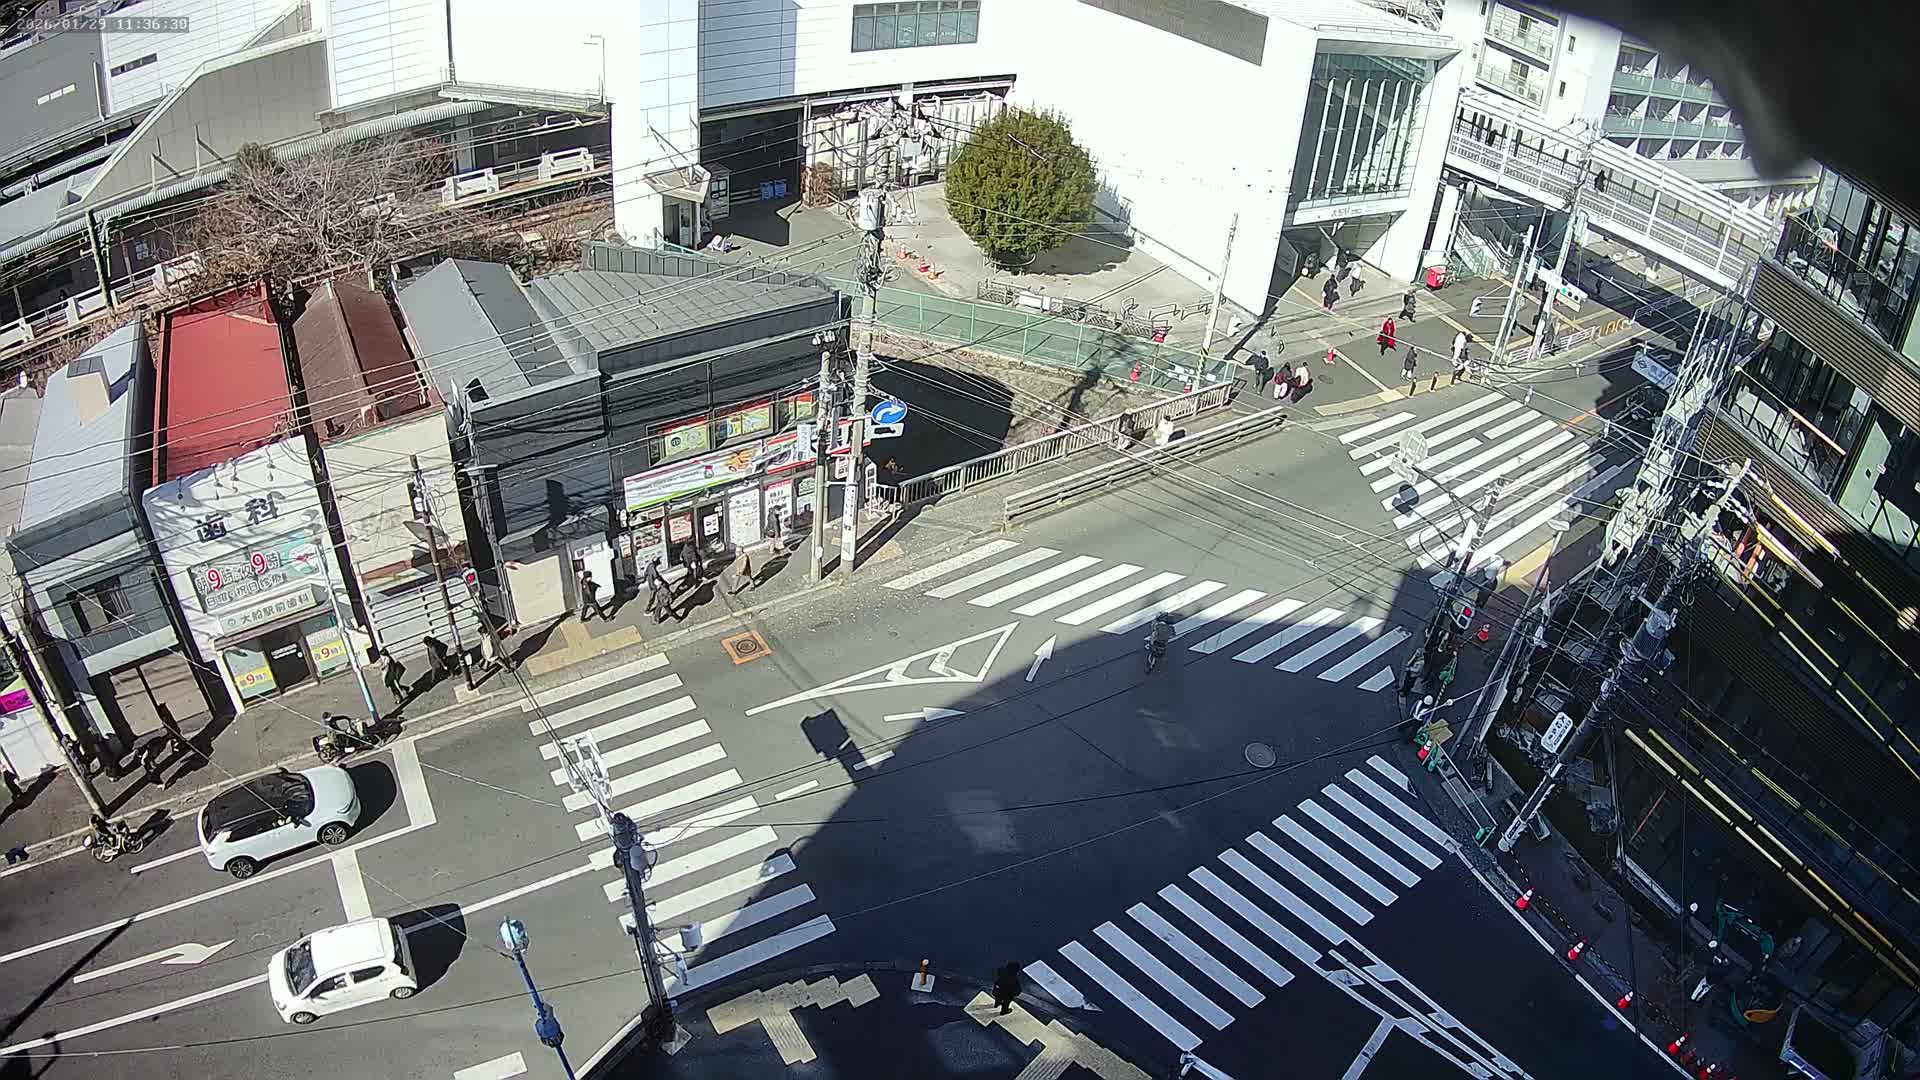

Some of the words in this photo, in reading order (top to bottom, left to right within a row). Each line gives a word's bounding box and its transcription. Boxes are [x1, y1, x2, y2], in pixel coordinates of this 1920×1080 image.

[196, 491, 282, 542] 歯科
[241, 592, 310, 625] 大船駅前歯科
